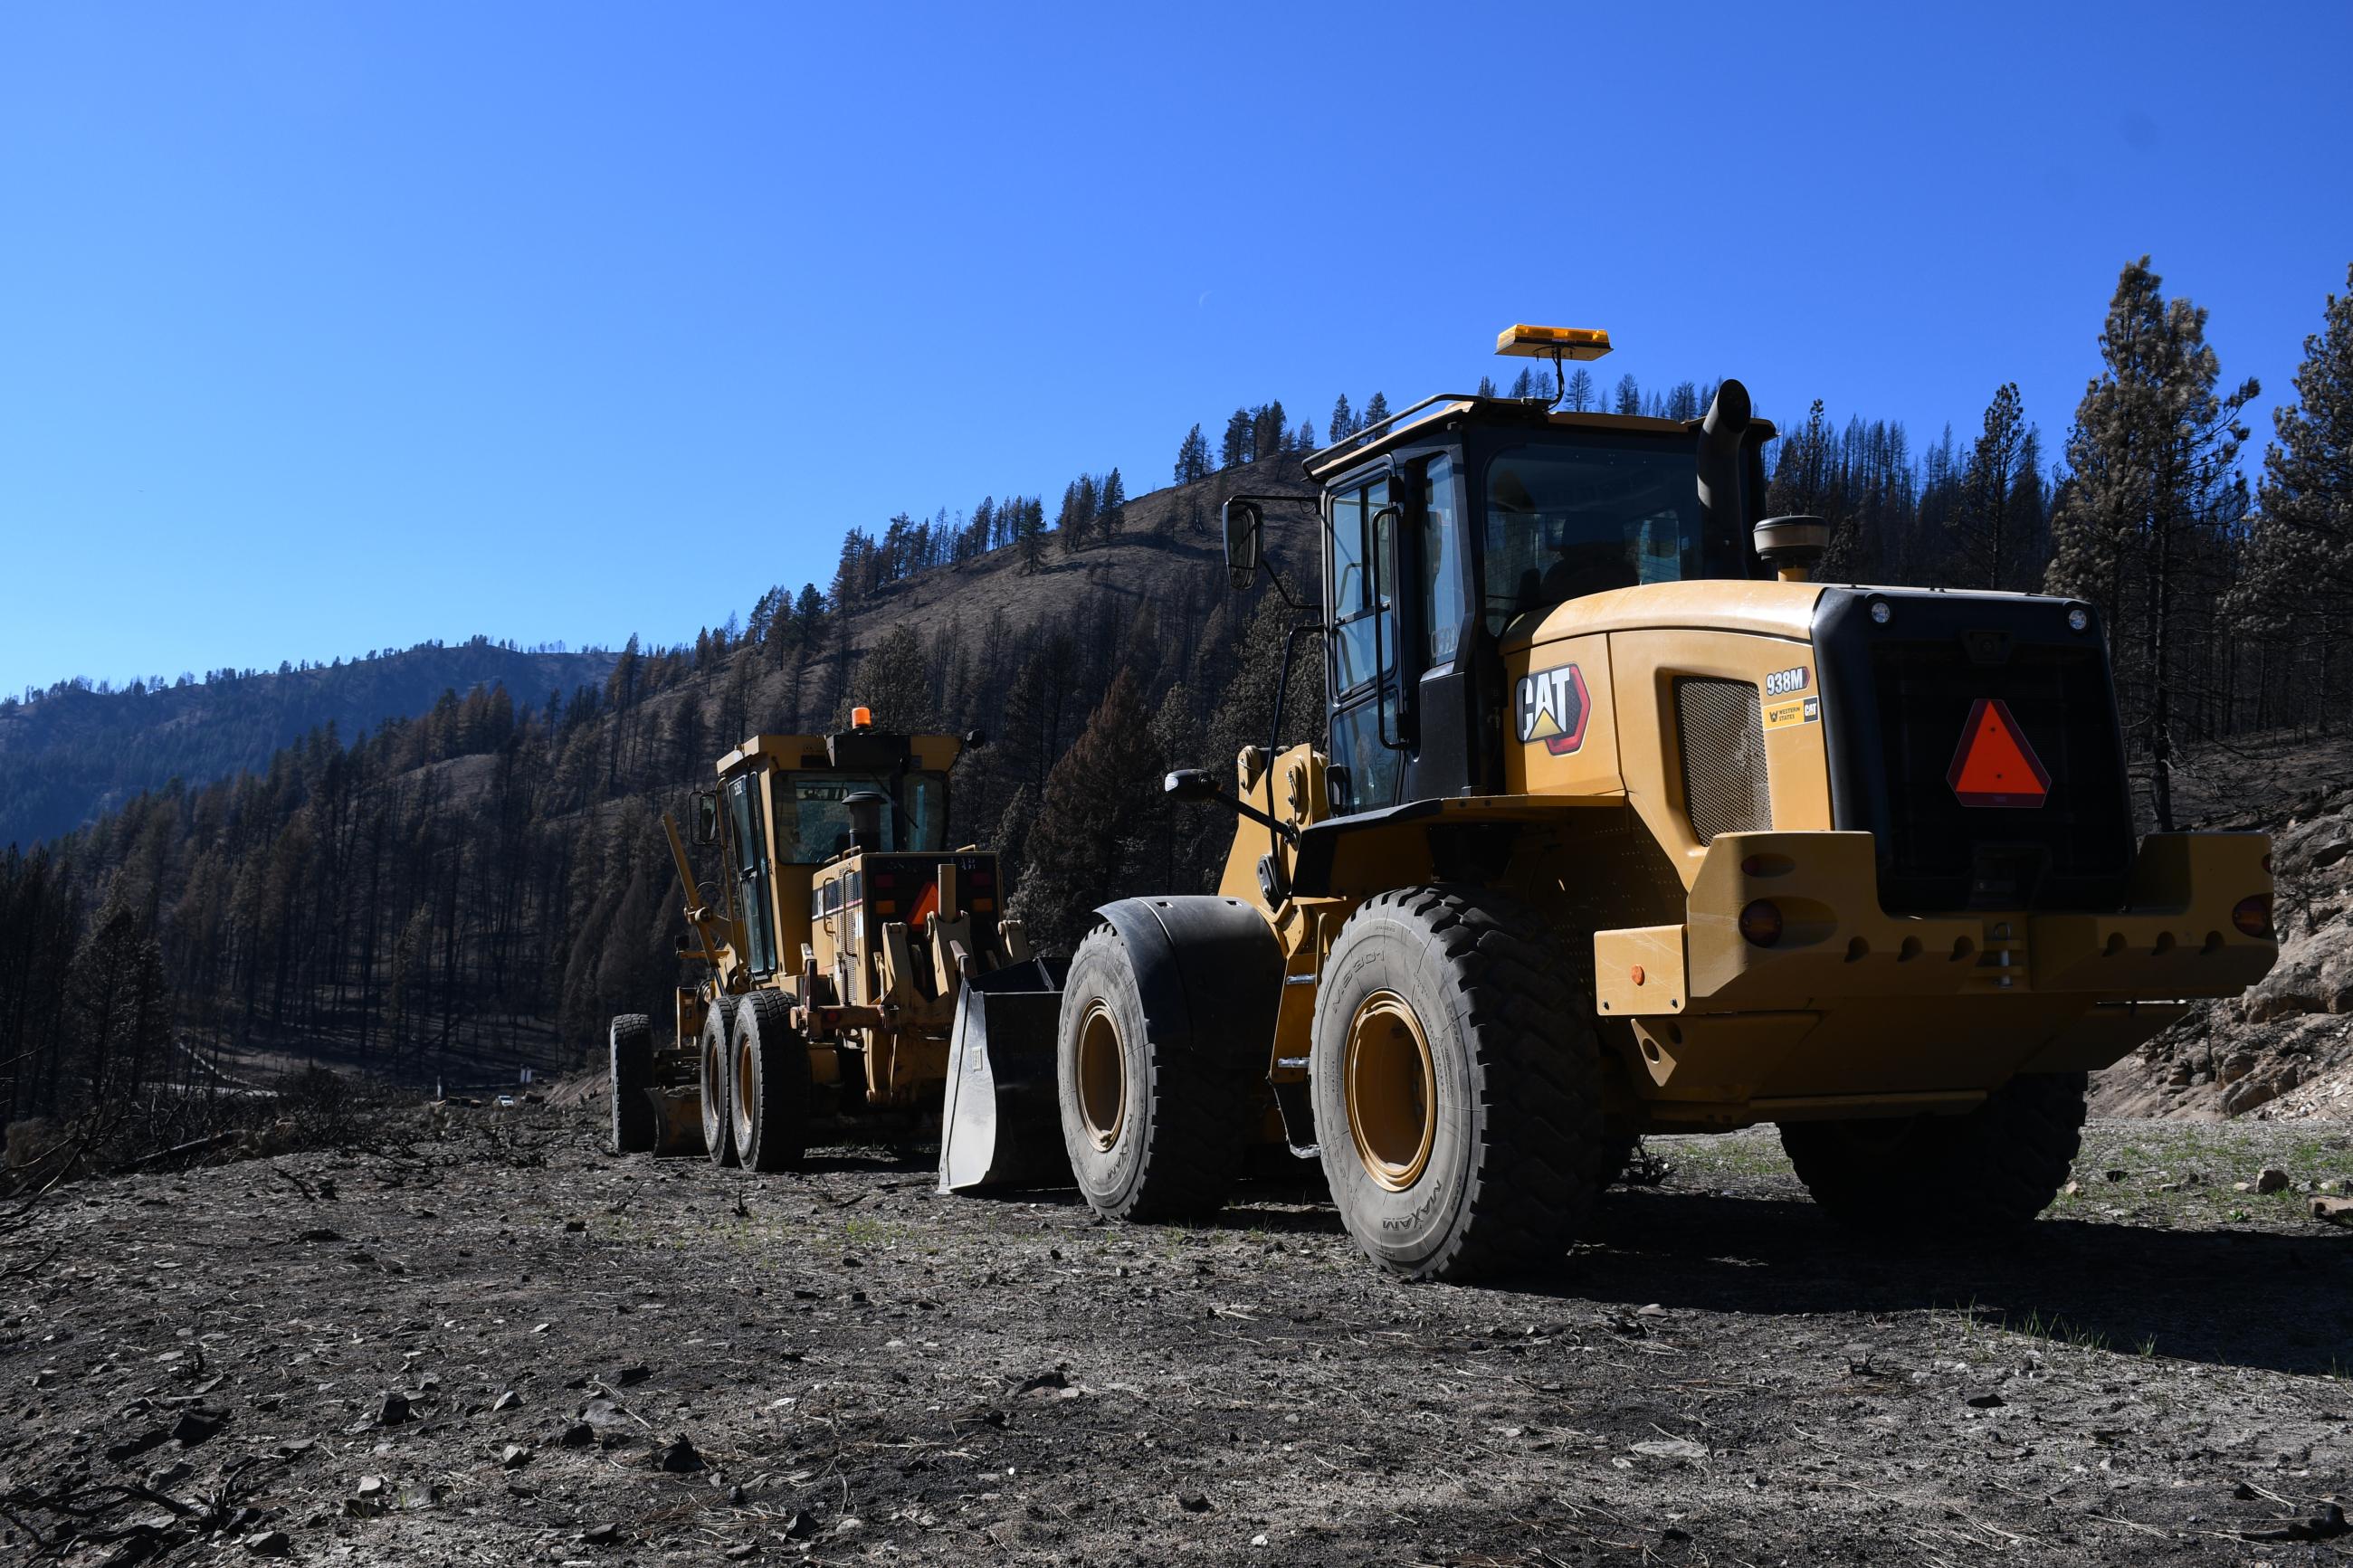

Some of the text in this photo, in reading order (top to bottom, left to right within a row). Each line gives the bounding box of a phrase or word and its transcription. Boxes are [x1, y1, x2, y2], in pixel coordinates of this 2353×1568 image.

[1767, 668, 1803, 696] 938M
[1516, 668, 1570, 741] CAT
[1779, 707, 1800, 715] WESTERN
[1805, 703, 1817, 717] CAT
[1108, 1114, 1133, 1180] MAXAM
[1382, 1178, 1443, 1231] MAXAM
